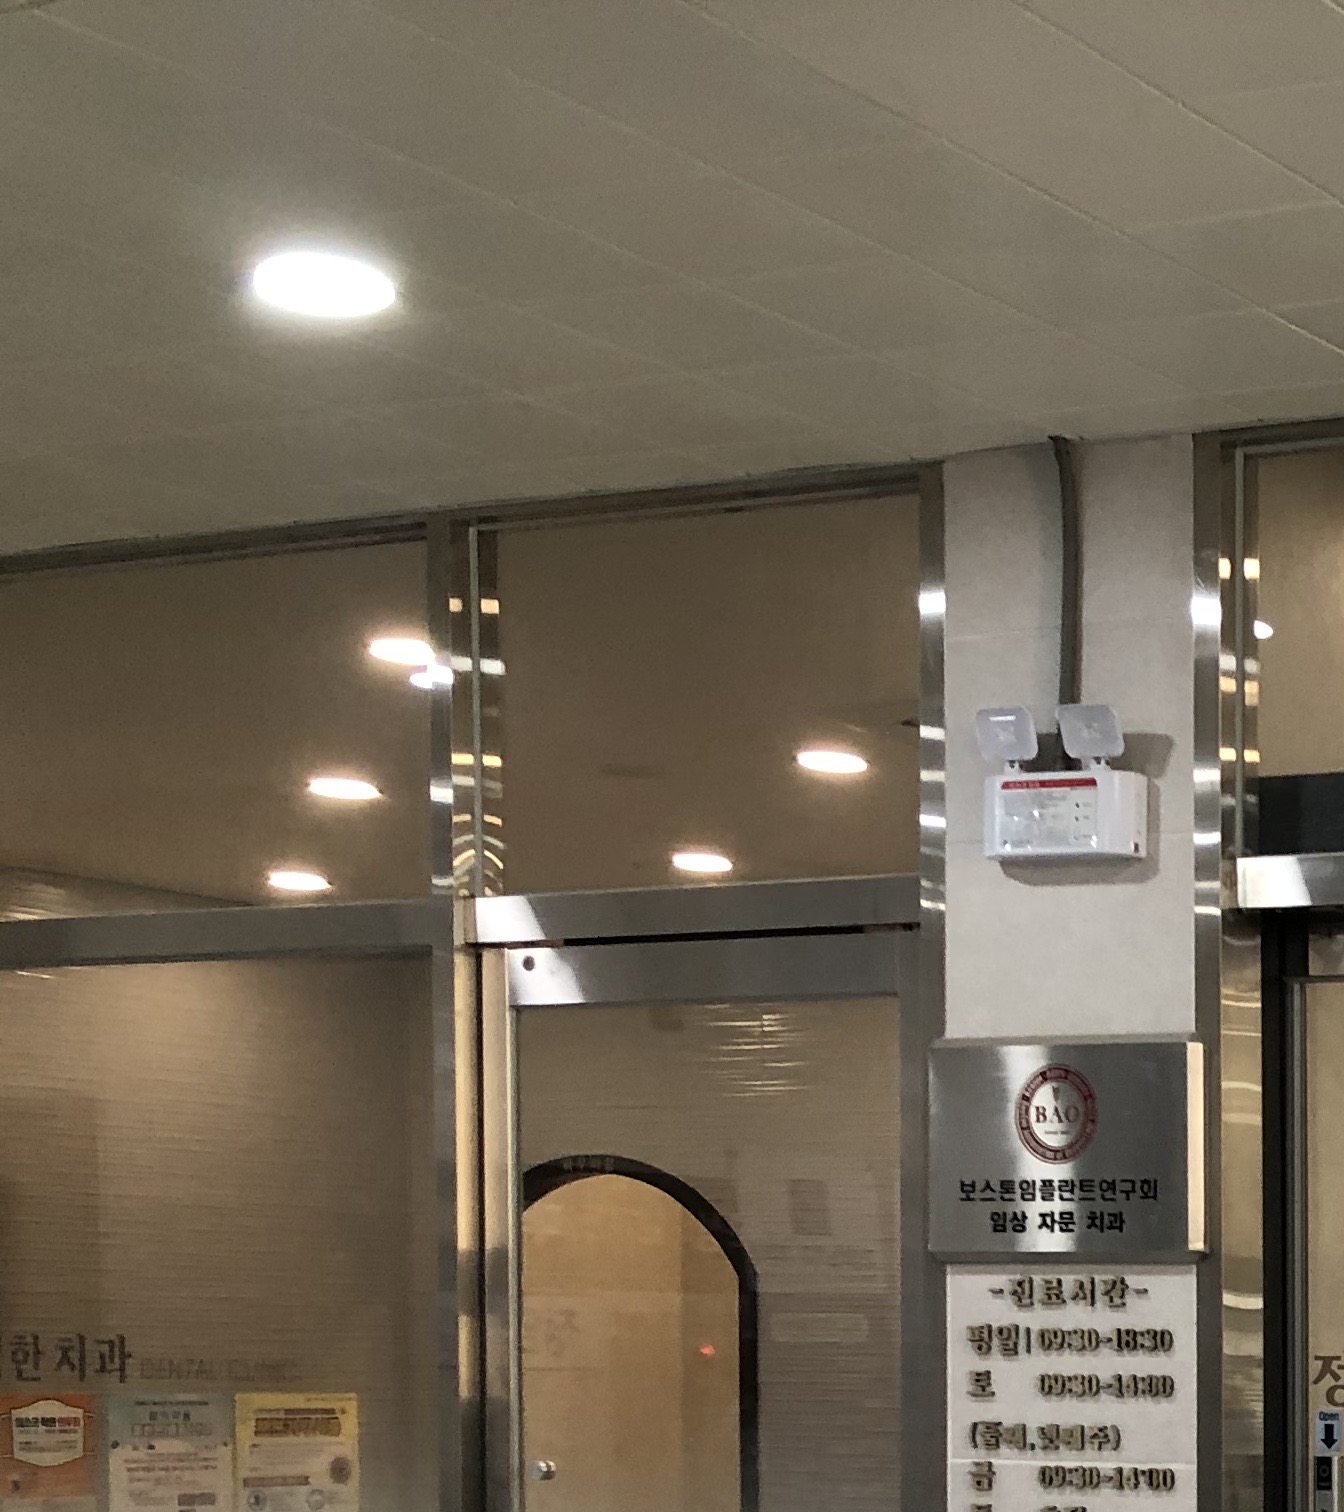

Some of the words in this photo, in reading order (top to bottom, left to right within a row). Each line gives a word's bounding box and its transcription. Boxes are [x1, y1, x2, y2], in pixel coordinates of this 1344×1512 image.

[959, 1178, 1158, 1201] 보스톤임플란트연구회
[990, 1211, 1028, 1233] 임상
[1038, 1211, 1075, 1233] 자문
[1086, 1211, 1125, 1233] 치과
[0, 1333, 132, 1383] 한치과
